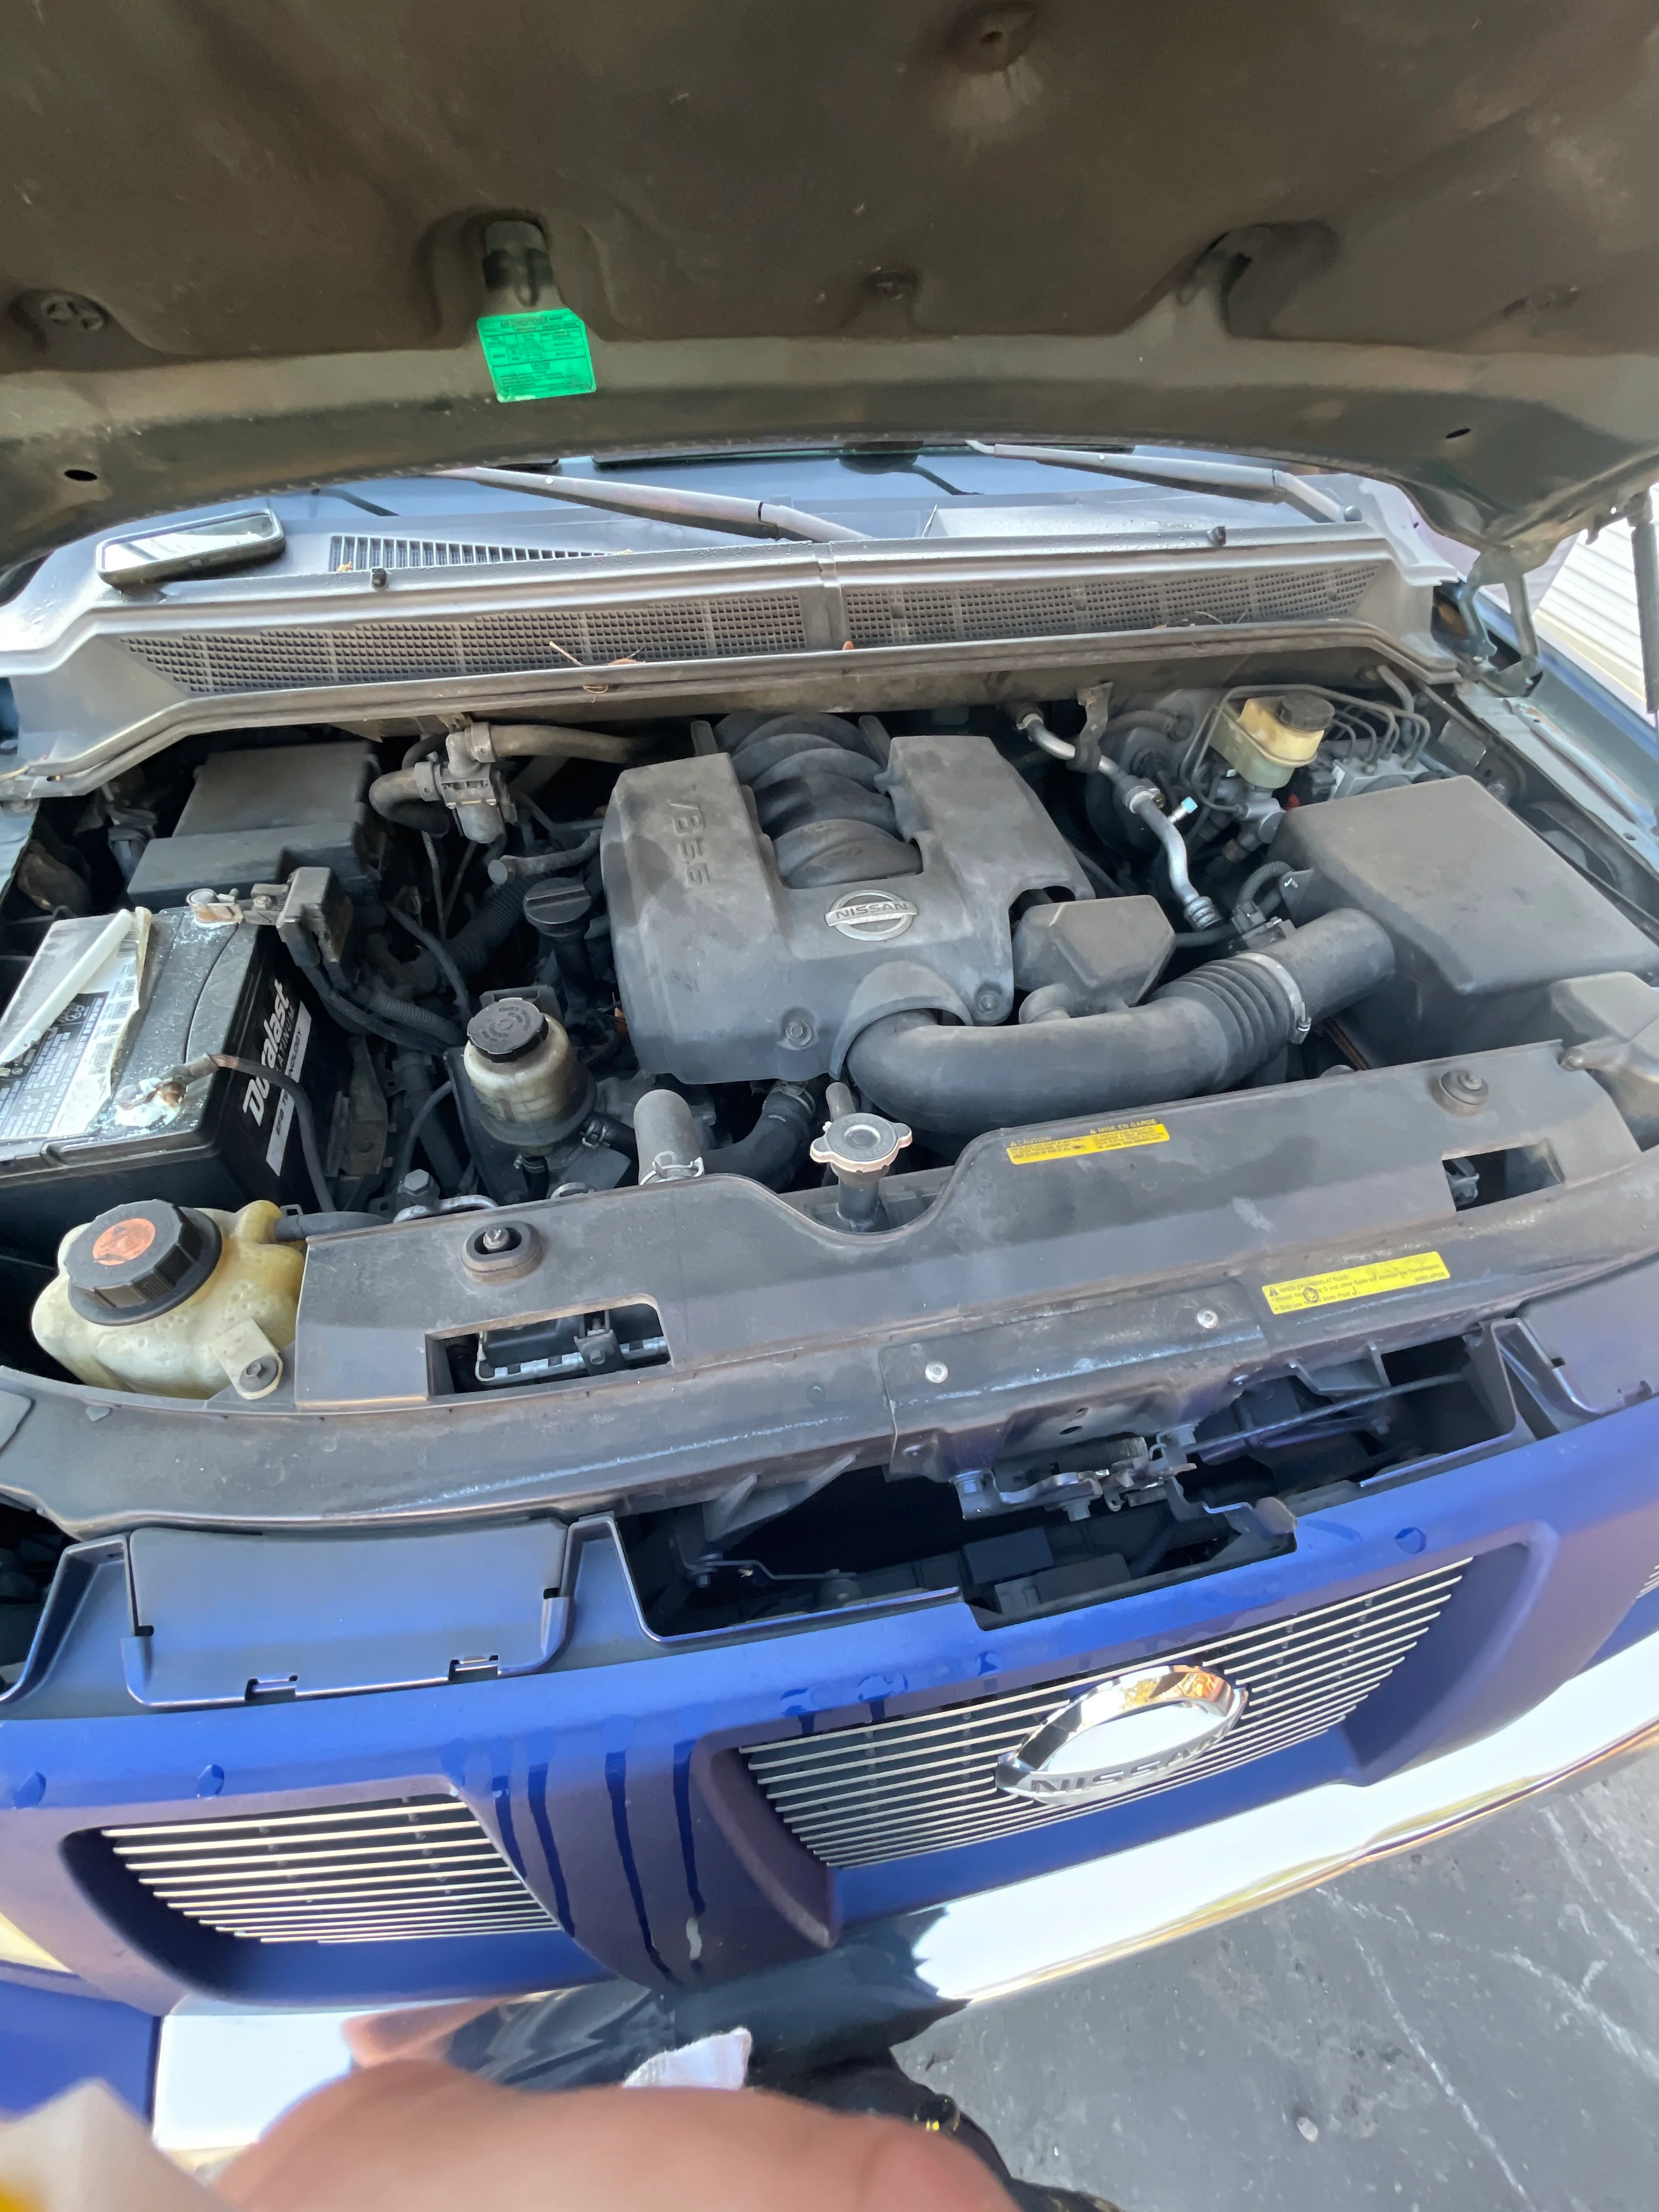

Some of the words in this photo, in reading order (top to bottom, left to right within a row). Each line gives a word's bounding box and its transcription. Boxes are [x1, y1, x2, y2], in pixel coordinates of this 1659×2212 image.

[835, 902, 909, 919] NISSAN
[275, 1005, 295, 1072] LATINUM
[282, 1028, 302, 1107] TENOLOGY
[1017, 1136, 1052, 1146] CAUTION
[1098, 1124, 1116, 1133] MISE
[1118, 1122, 1128, 1131] EN
[1130, 1119, 1157, 1129] GARDE
[1030, 1725, 1226, 1795] NISSAN
